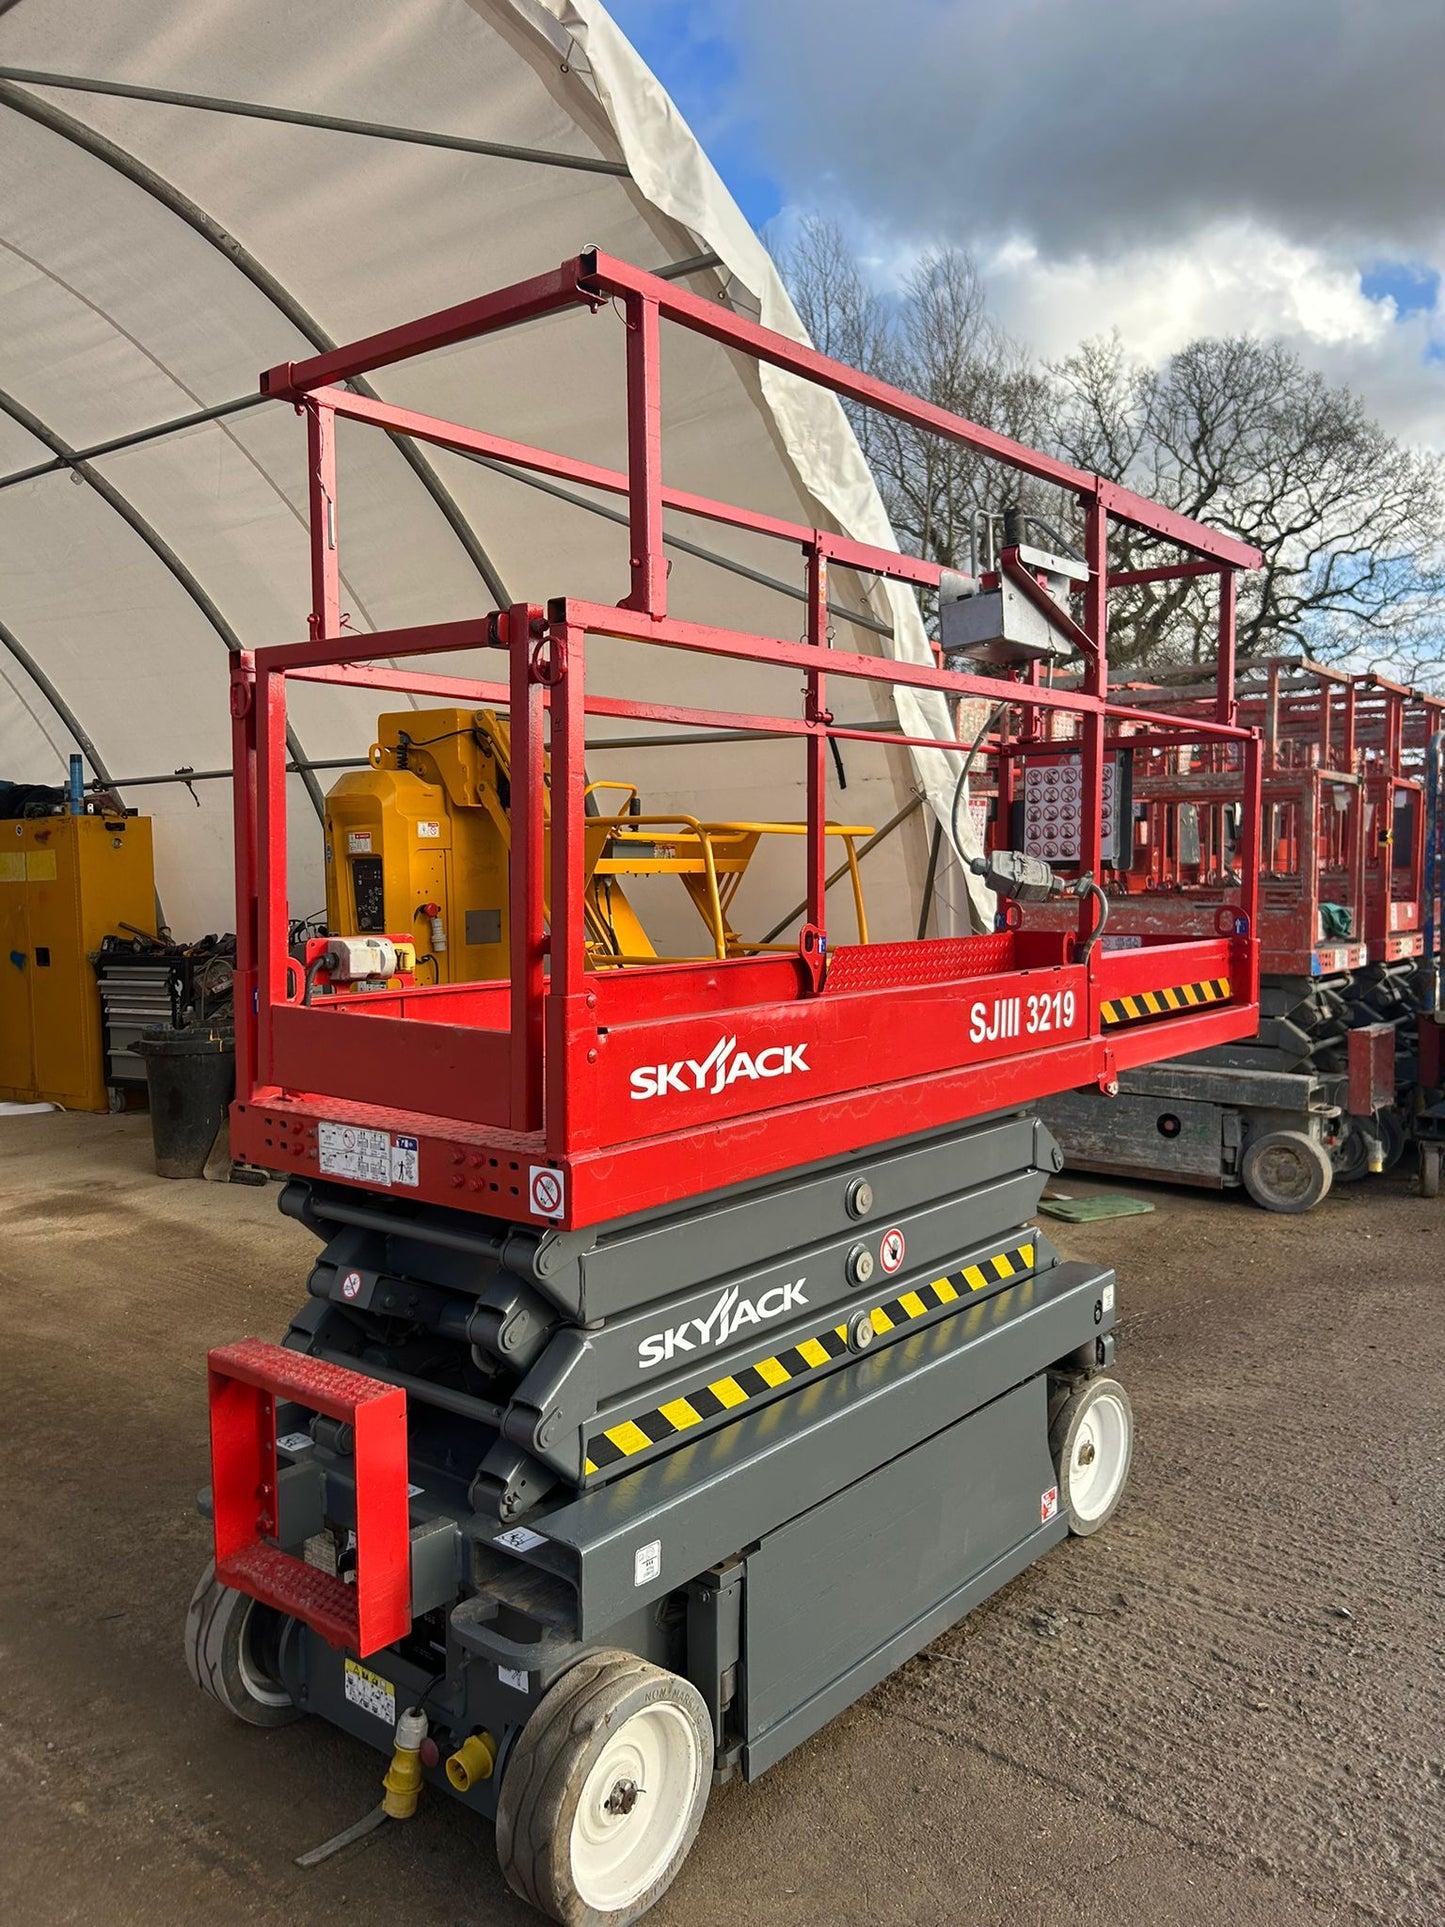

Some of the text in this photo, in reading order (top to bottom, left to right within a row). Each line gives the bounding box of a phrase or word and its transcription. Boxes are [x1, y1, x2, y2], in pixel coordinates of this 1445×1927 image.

[969, 990, 1075, 1044] SJIII 3219
[629, 1034, 811, 1100] SKYJACK
[638, 1278, 809, 1370] SKYJACK
